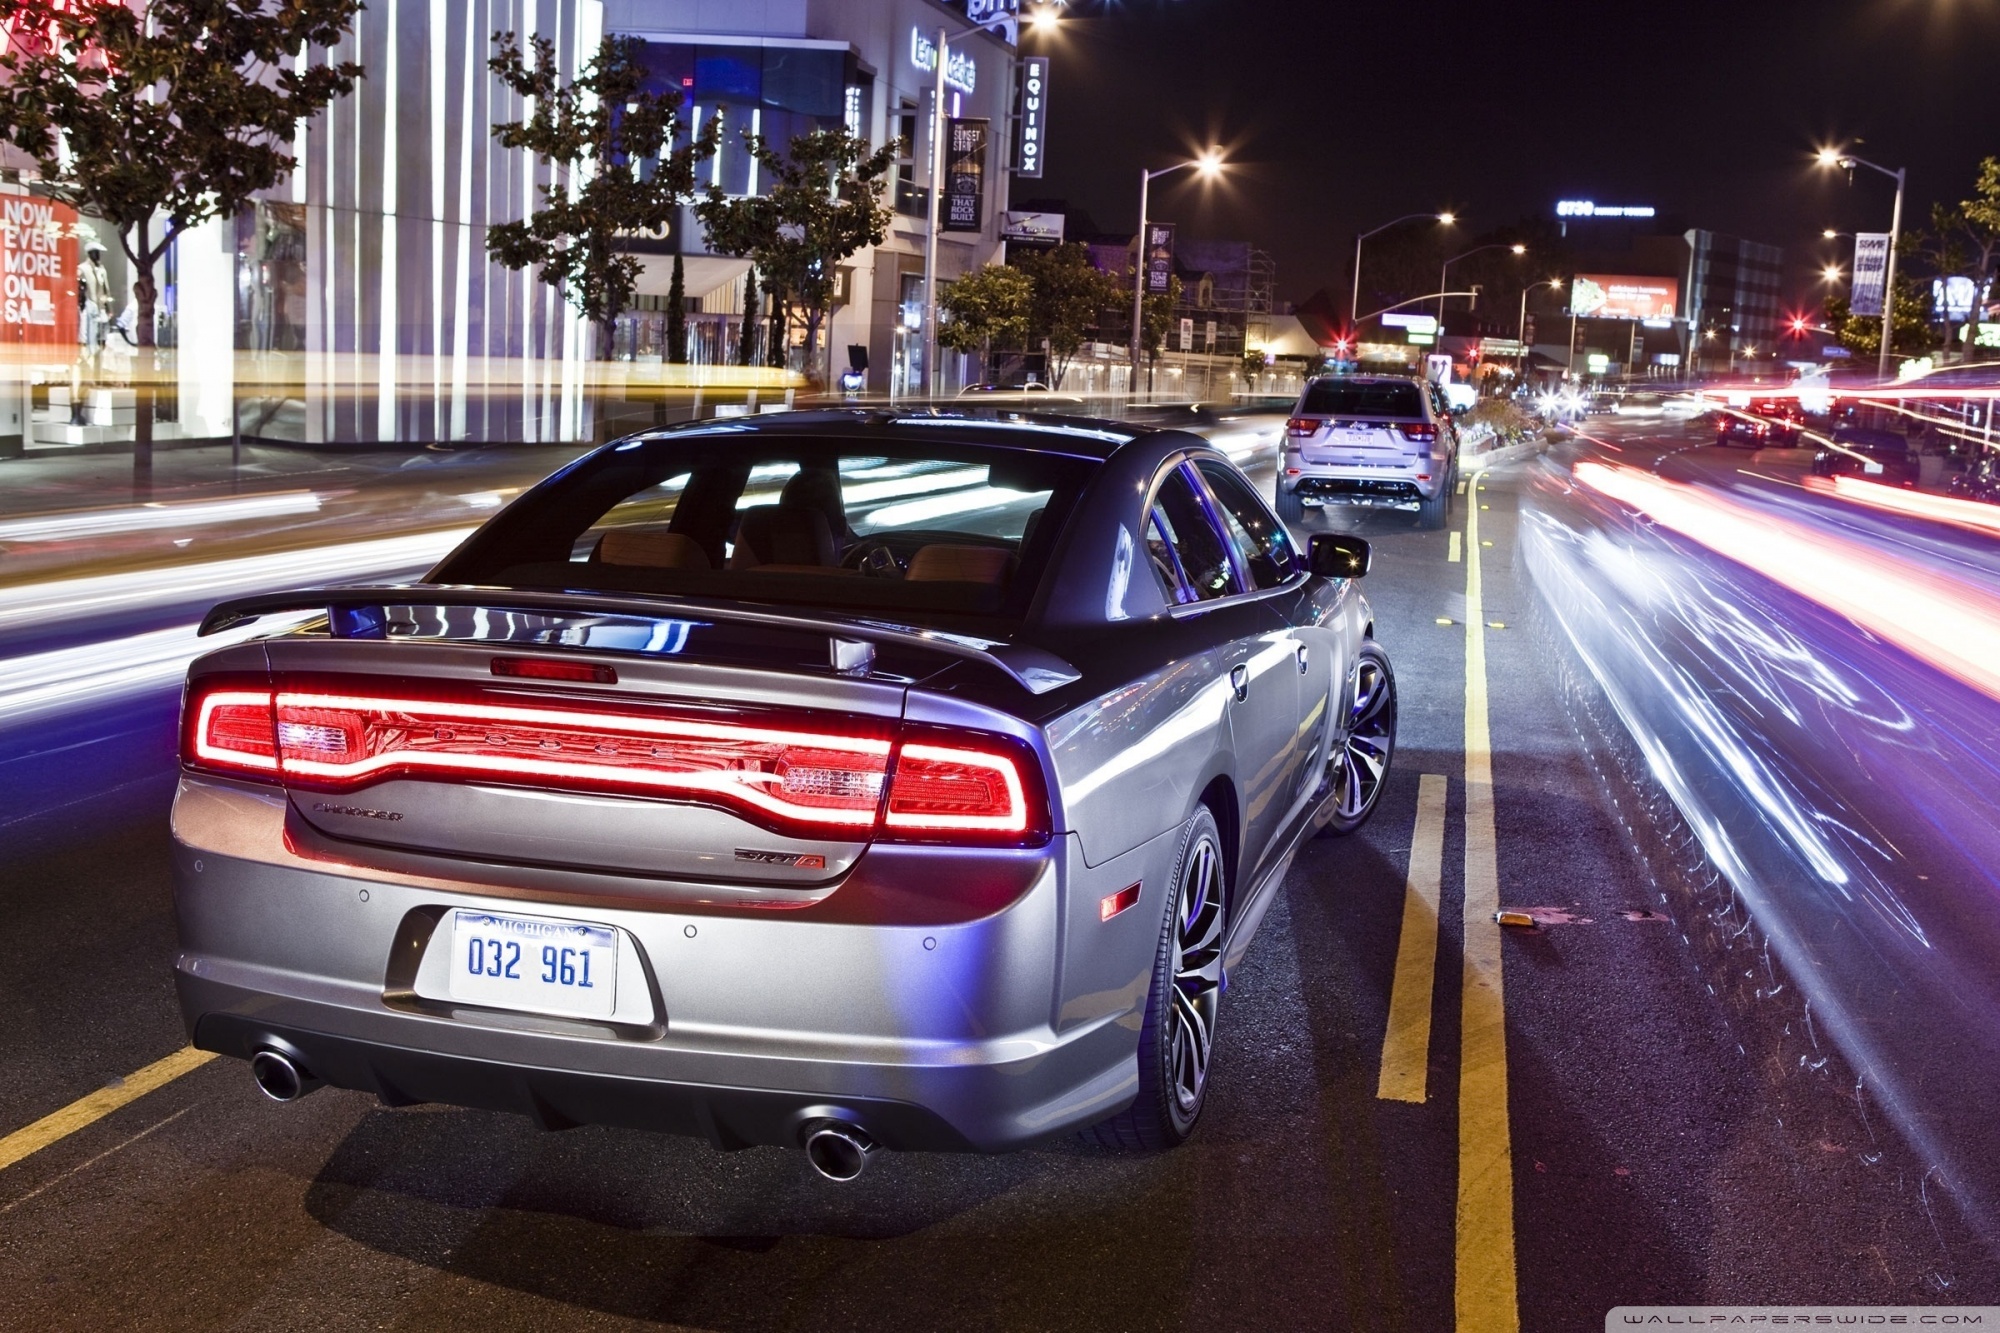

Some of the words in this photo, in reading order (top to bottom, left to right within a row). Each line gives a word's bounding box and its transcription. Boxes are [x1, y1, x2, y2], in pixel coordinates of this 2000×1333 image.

[1023, 63, 1041, 171] EQUINOX
[953, 140, 974, 152] STRIP
[954, 130, 980, 141] SUNSET
[4, 199, 54, 229] NOW
[951, 199, 976, 207] THAT
[4, 225, 59, 253] EVEN
[4, 249, 62, 278] MORE
[1856, 263, 1883, 272] STRIP
[4, 274, 35, 300] ON
[494, 919, 575, 939] MICHIGAN
[468, 936, 521, 980] 032
[541, 945, 594, 988] 961
